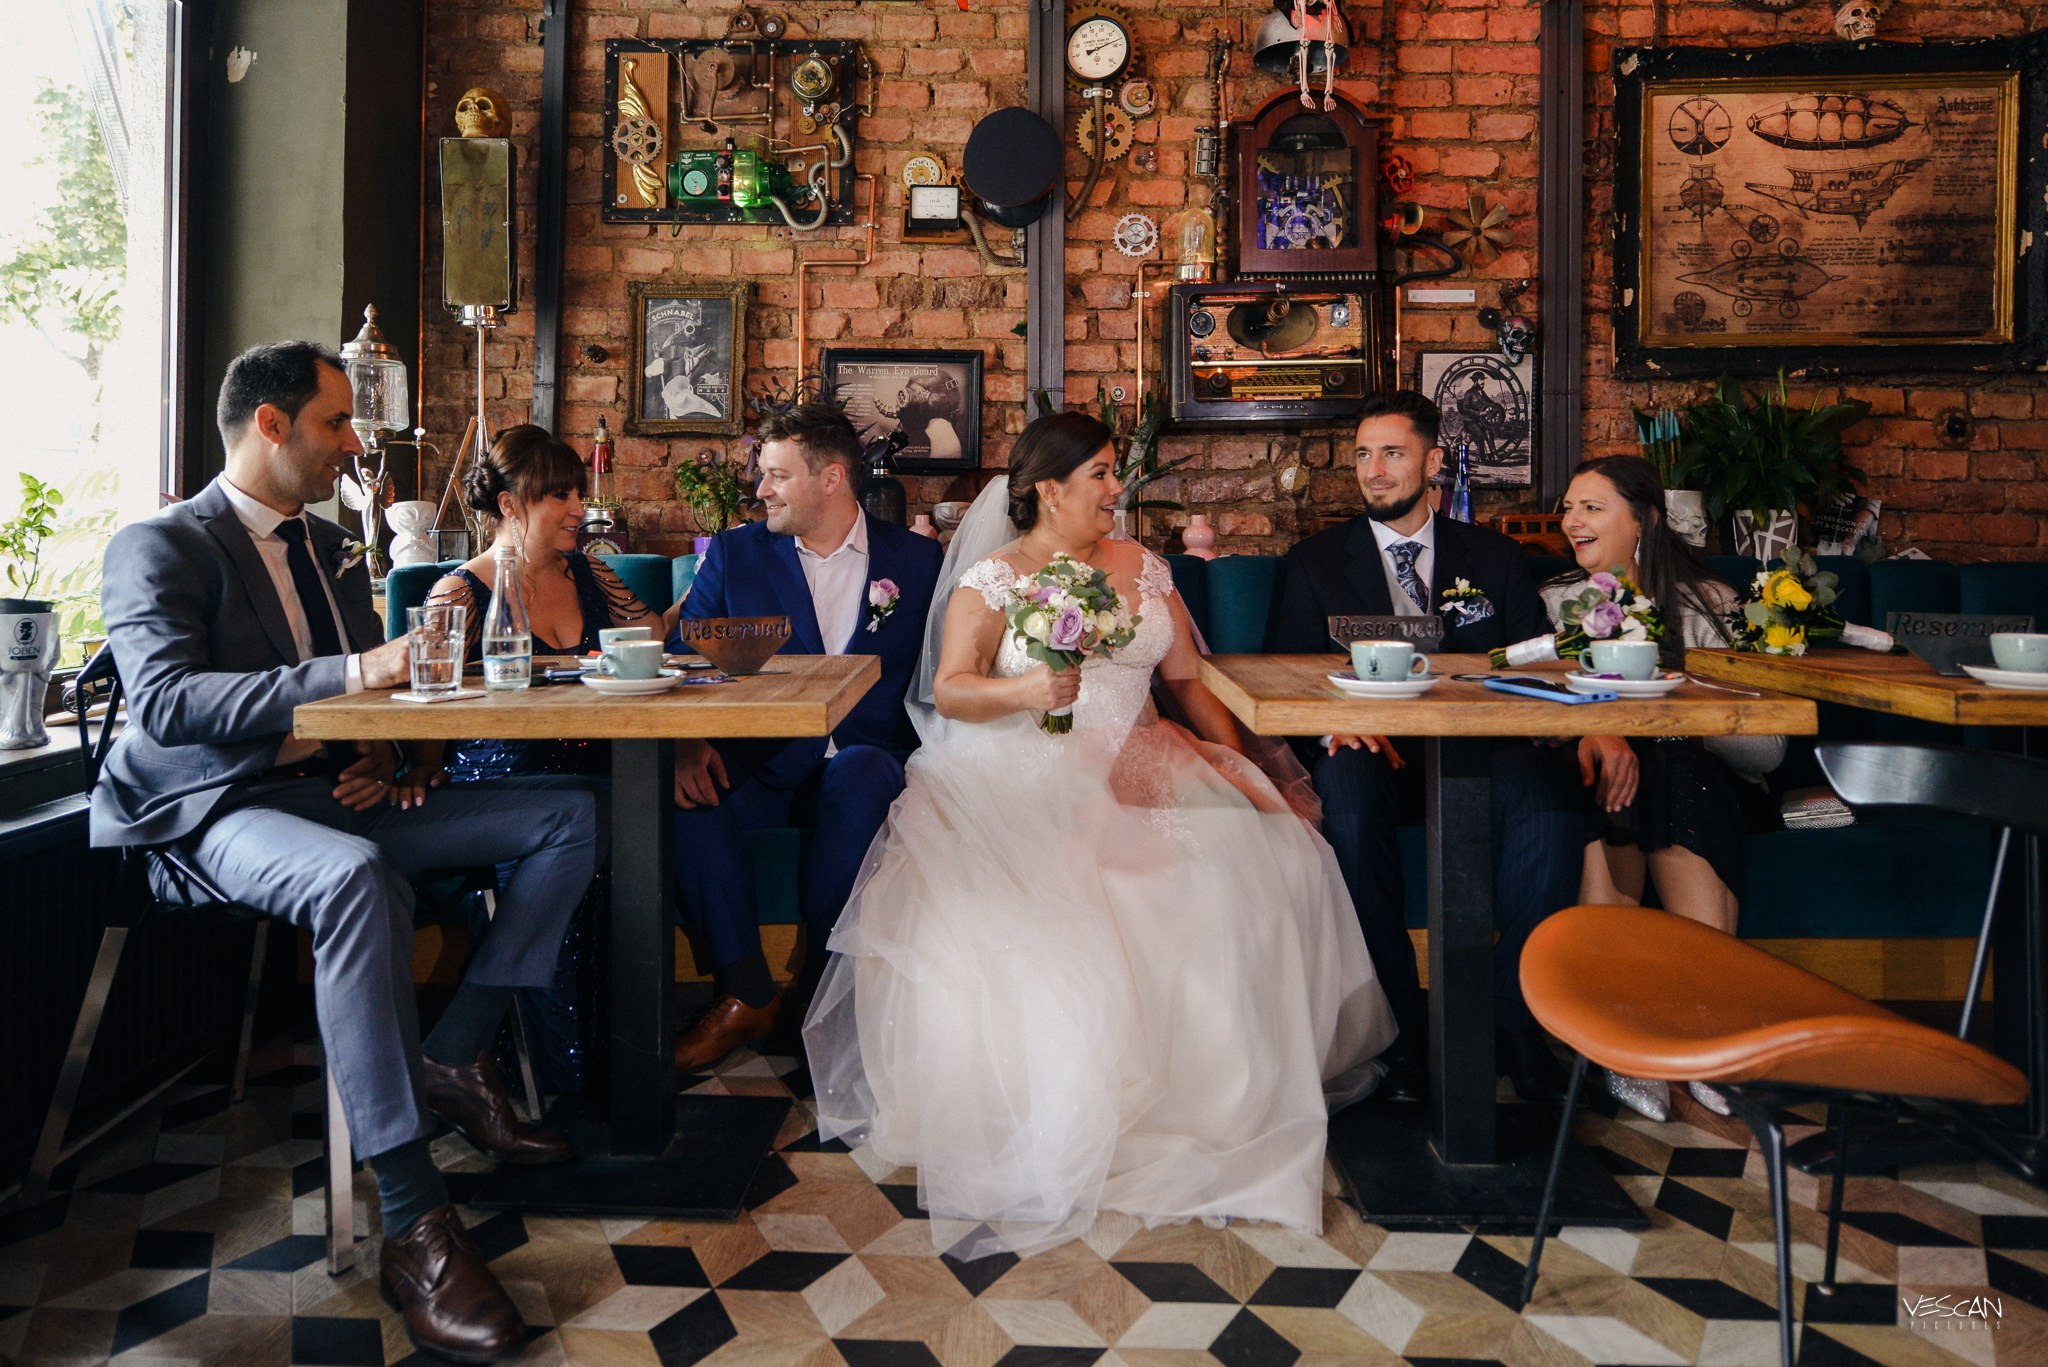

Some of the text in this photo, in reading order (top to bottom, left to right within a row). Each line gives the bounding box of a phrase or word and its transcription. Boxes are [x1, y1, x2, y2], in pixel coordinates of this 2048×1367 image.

[651, 309, 695, 322] SCHNABEL
[838, 365, 853, 374] The
[858, 365, 889, 375] Warren
[894, 366, 910, 377] Eye
[913, 366, 939, 376] Guard
[686, 617, 790, 641] Reserved
[1334, 616, 1443, 638] Reserved
[1892, 613, 2031, 638] Reserved
